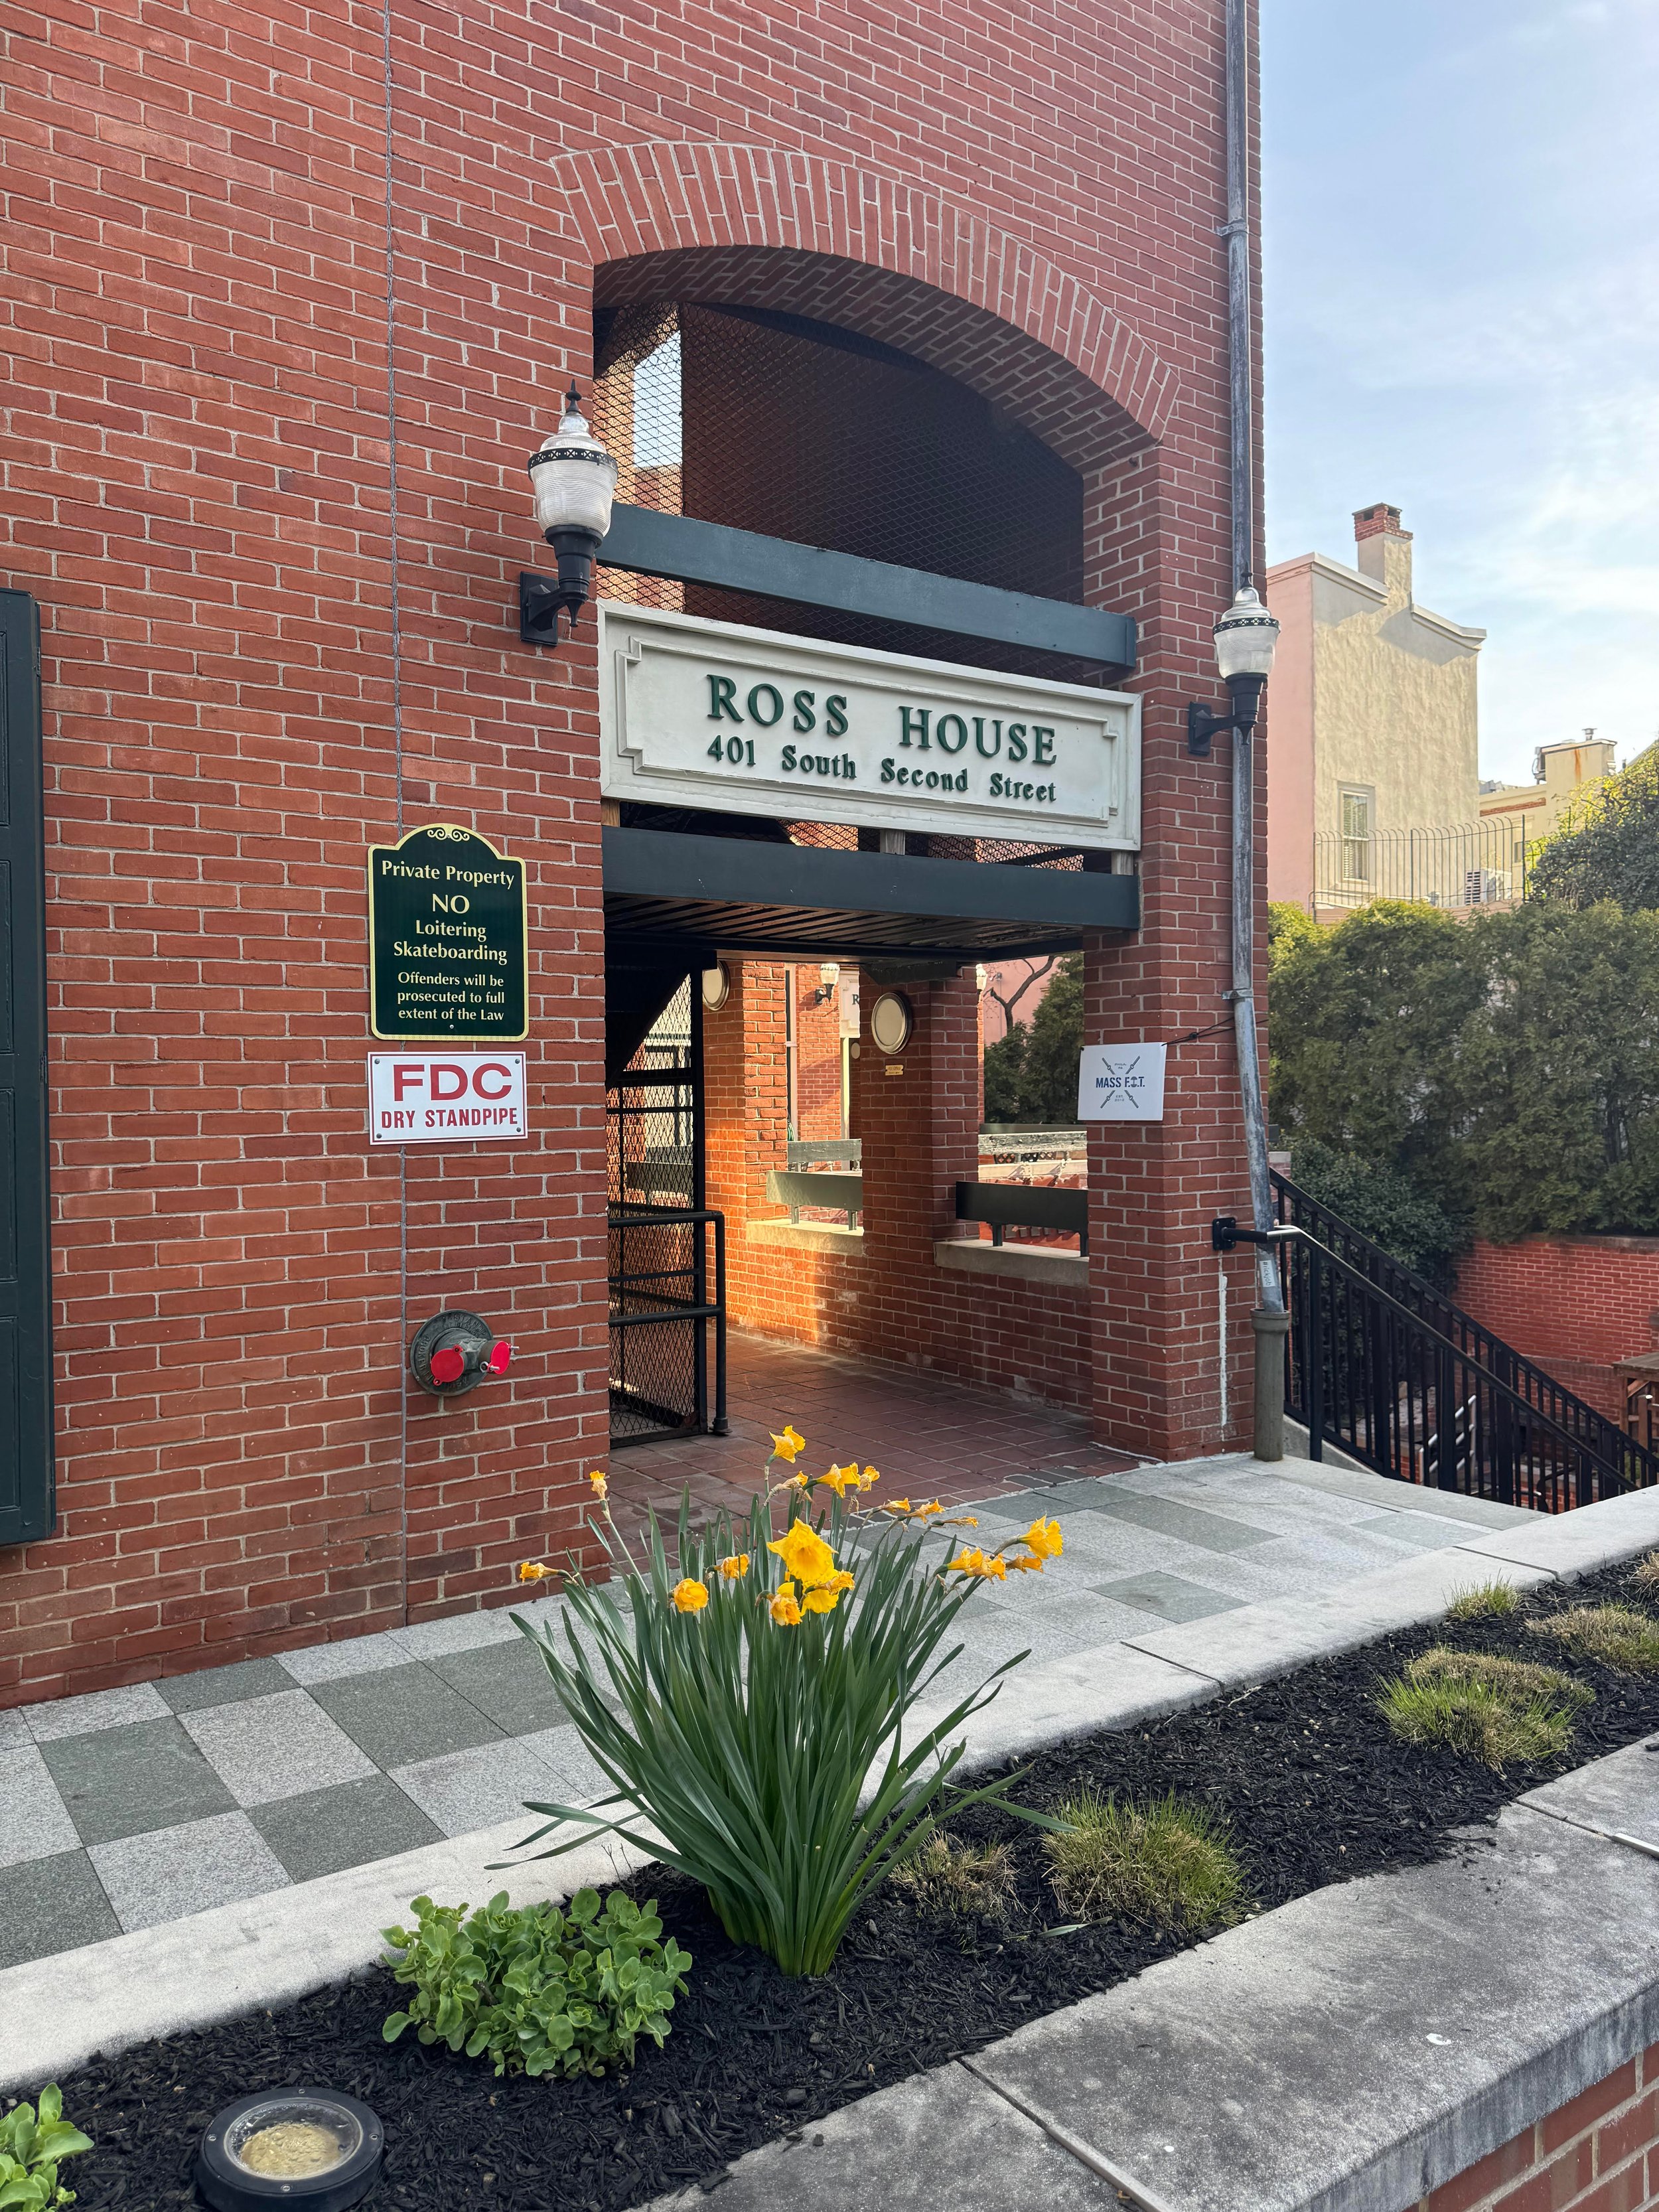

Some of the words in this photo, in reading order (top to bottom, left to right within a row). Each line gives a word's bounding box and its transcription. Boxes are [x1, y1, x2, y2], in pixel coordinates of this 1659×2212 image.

[706, 674, 849, 739] ROSS
[899, 706, 1057, 767] HOUSE
[707, 735, 756, 768] 401
[782, 745, 857, 780] South
[881, 758, 969, 793] Second
[989, 772, 1057, 804] Street
[382, 860, 440, 879] Private
[446, 865, 514, 890] Property
[432, 893, 470, 914] NO
[416, 919, 487, 942] Loitering
[394, 940, 508, 966] Skateboarding
[397, 971, 460, 986] Offenders
[463, 974, 486, 986] will
[490, 974, 504, 987] be
[397, 990, 466, 1005] prosecuted
[469, 992, 482, 1003] to
[486, 991, 504, 1003] full
[398, 1008, 437, 1019] extent
[441, 1007, 455, 1019] of
[457, 1007, 476, 1020] the
[480, 1009, 504, 1021] Law
[393, 1063, 512, 1102] FDC
[1096, 1076, 1121, 1088] MASS
[381, 1110, 415, 1129] DRY
[425, 1108, 518, 1128] STANDPIPE
